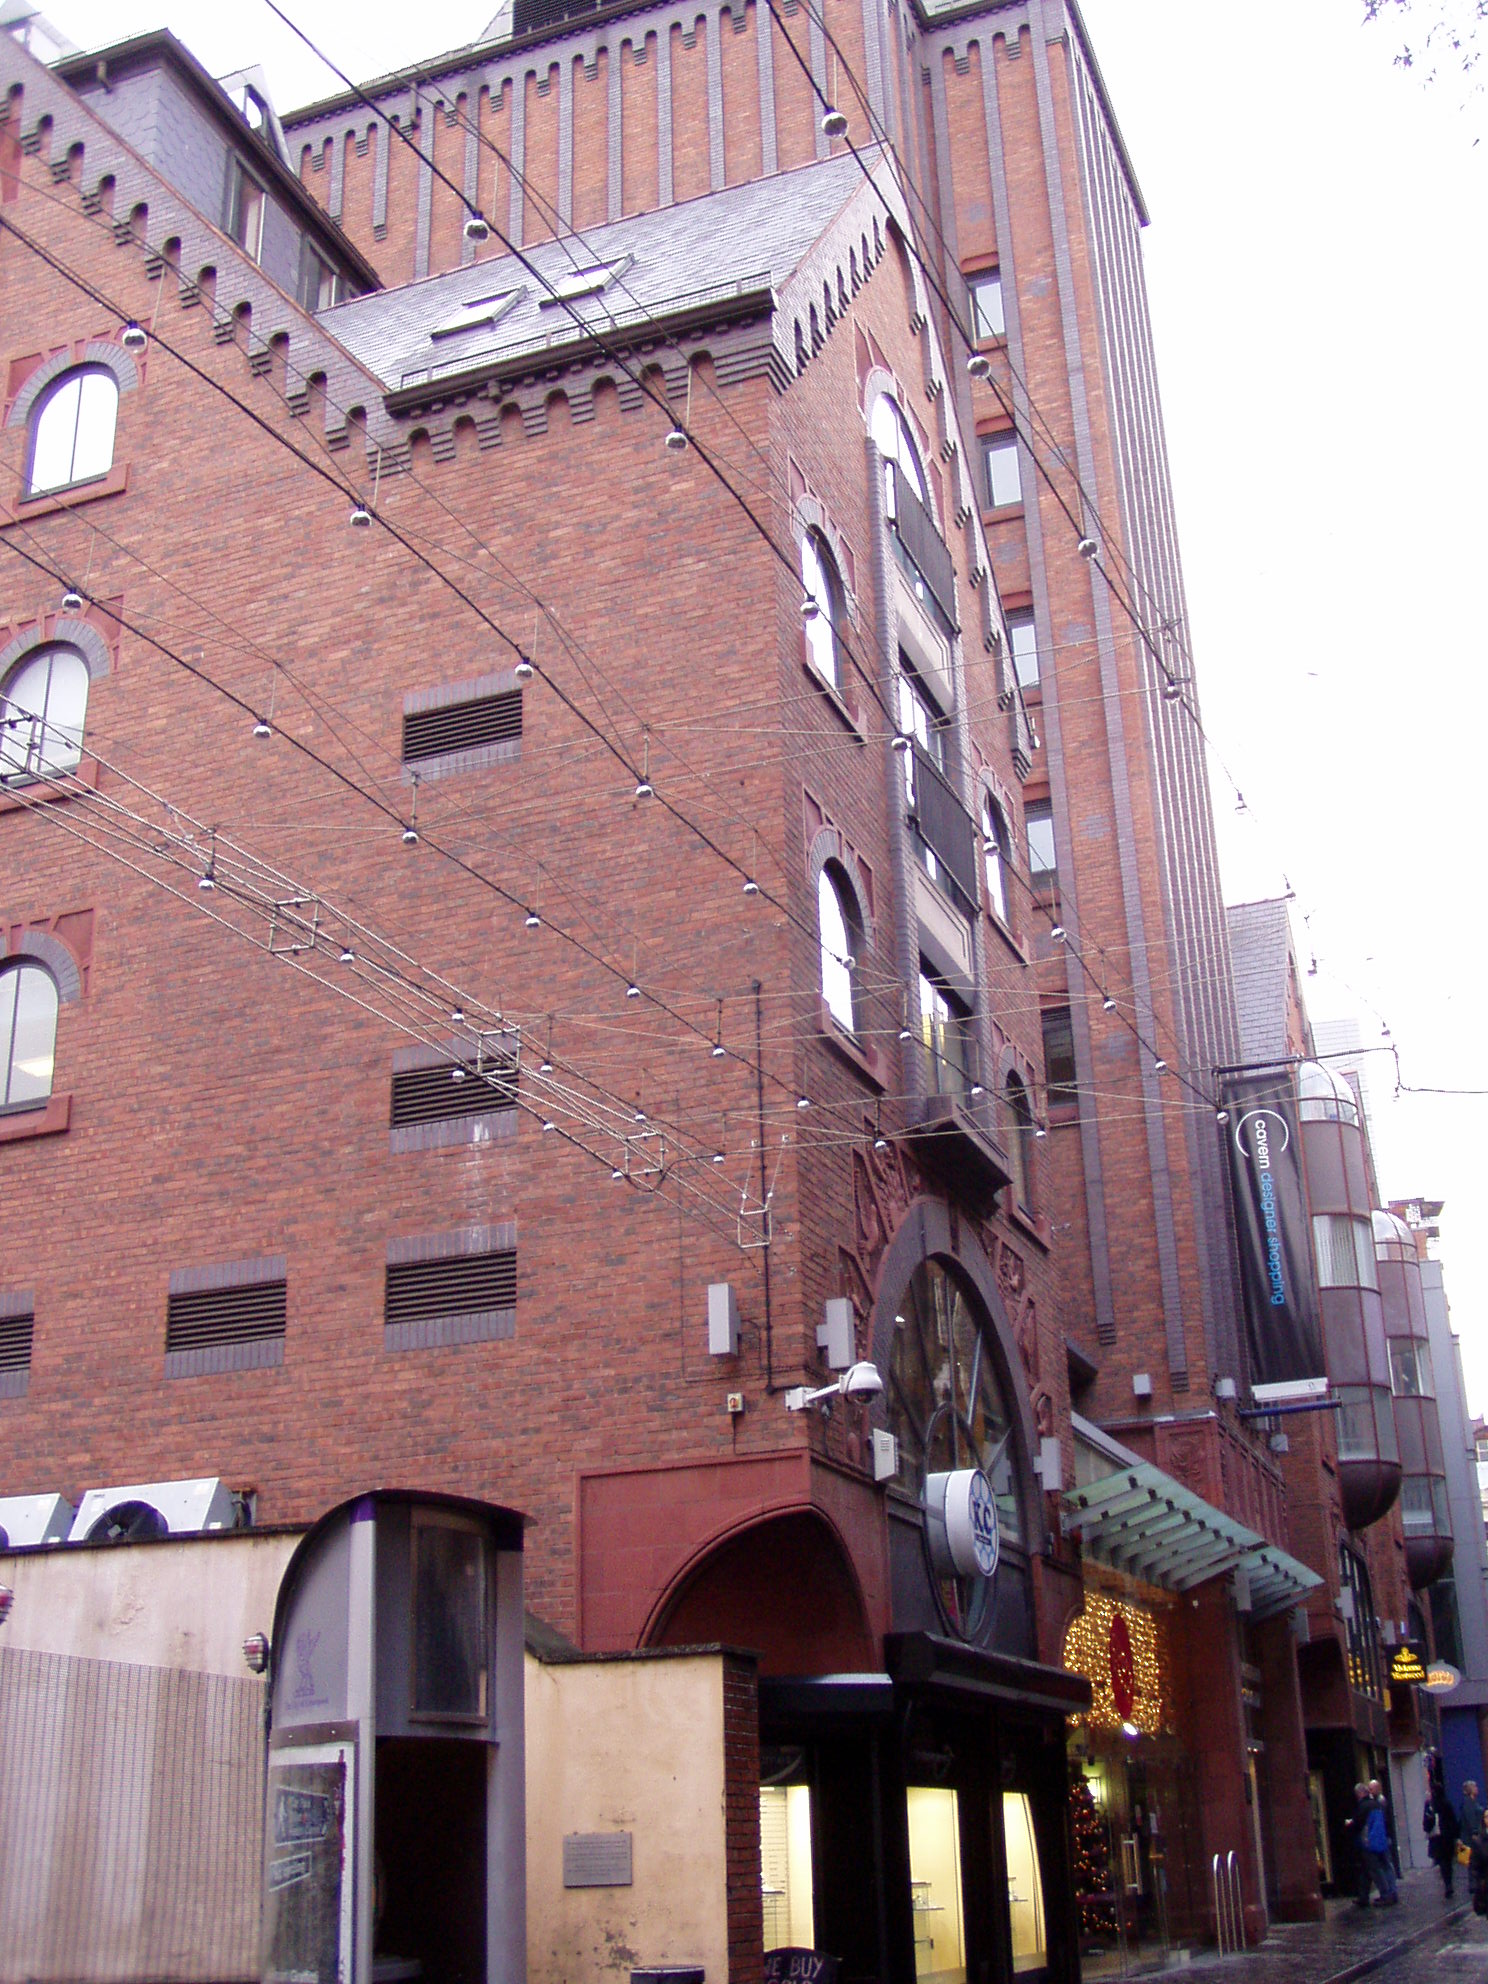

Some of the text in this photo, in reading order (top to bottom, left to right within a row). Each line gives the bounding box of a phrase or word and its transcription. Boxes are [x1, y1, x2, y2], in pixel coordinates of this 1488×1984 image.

[1255, 1119, 1285, 1305] cavern designer shopping
[789, 1956, 823, 1978] BUY
